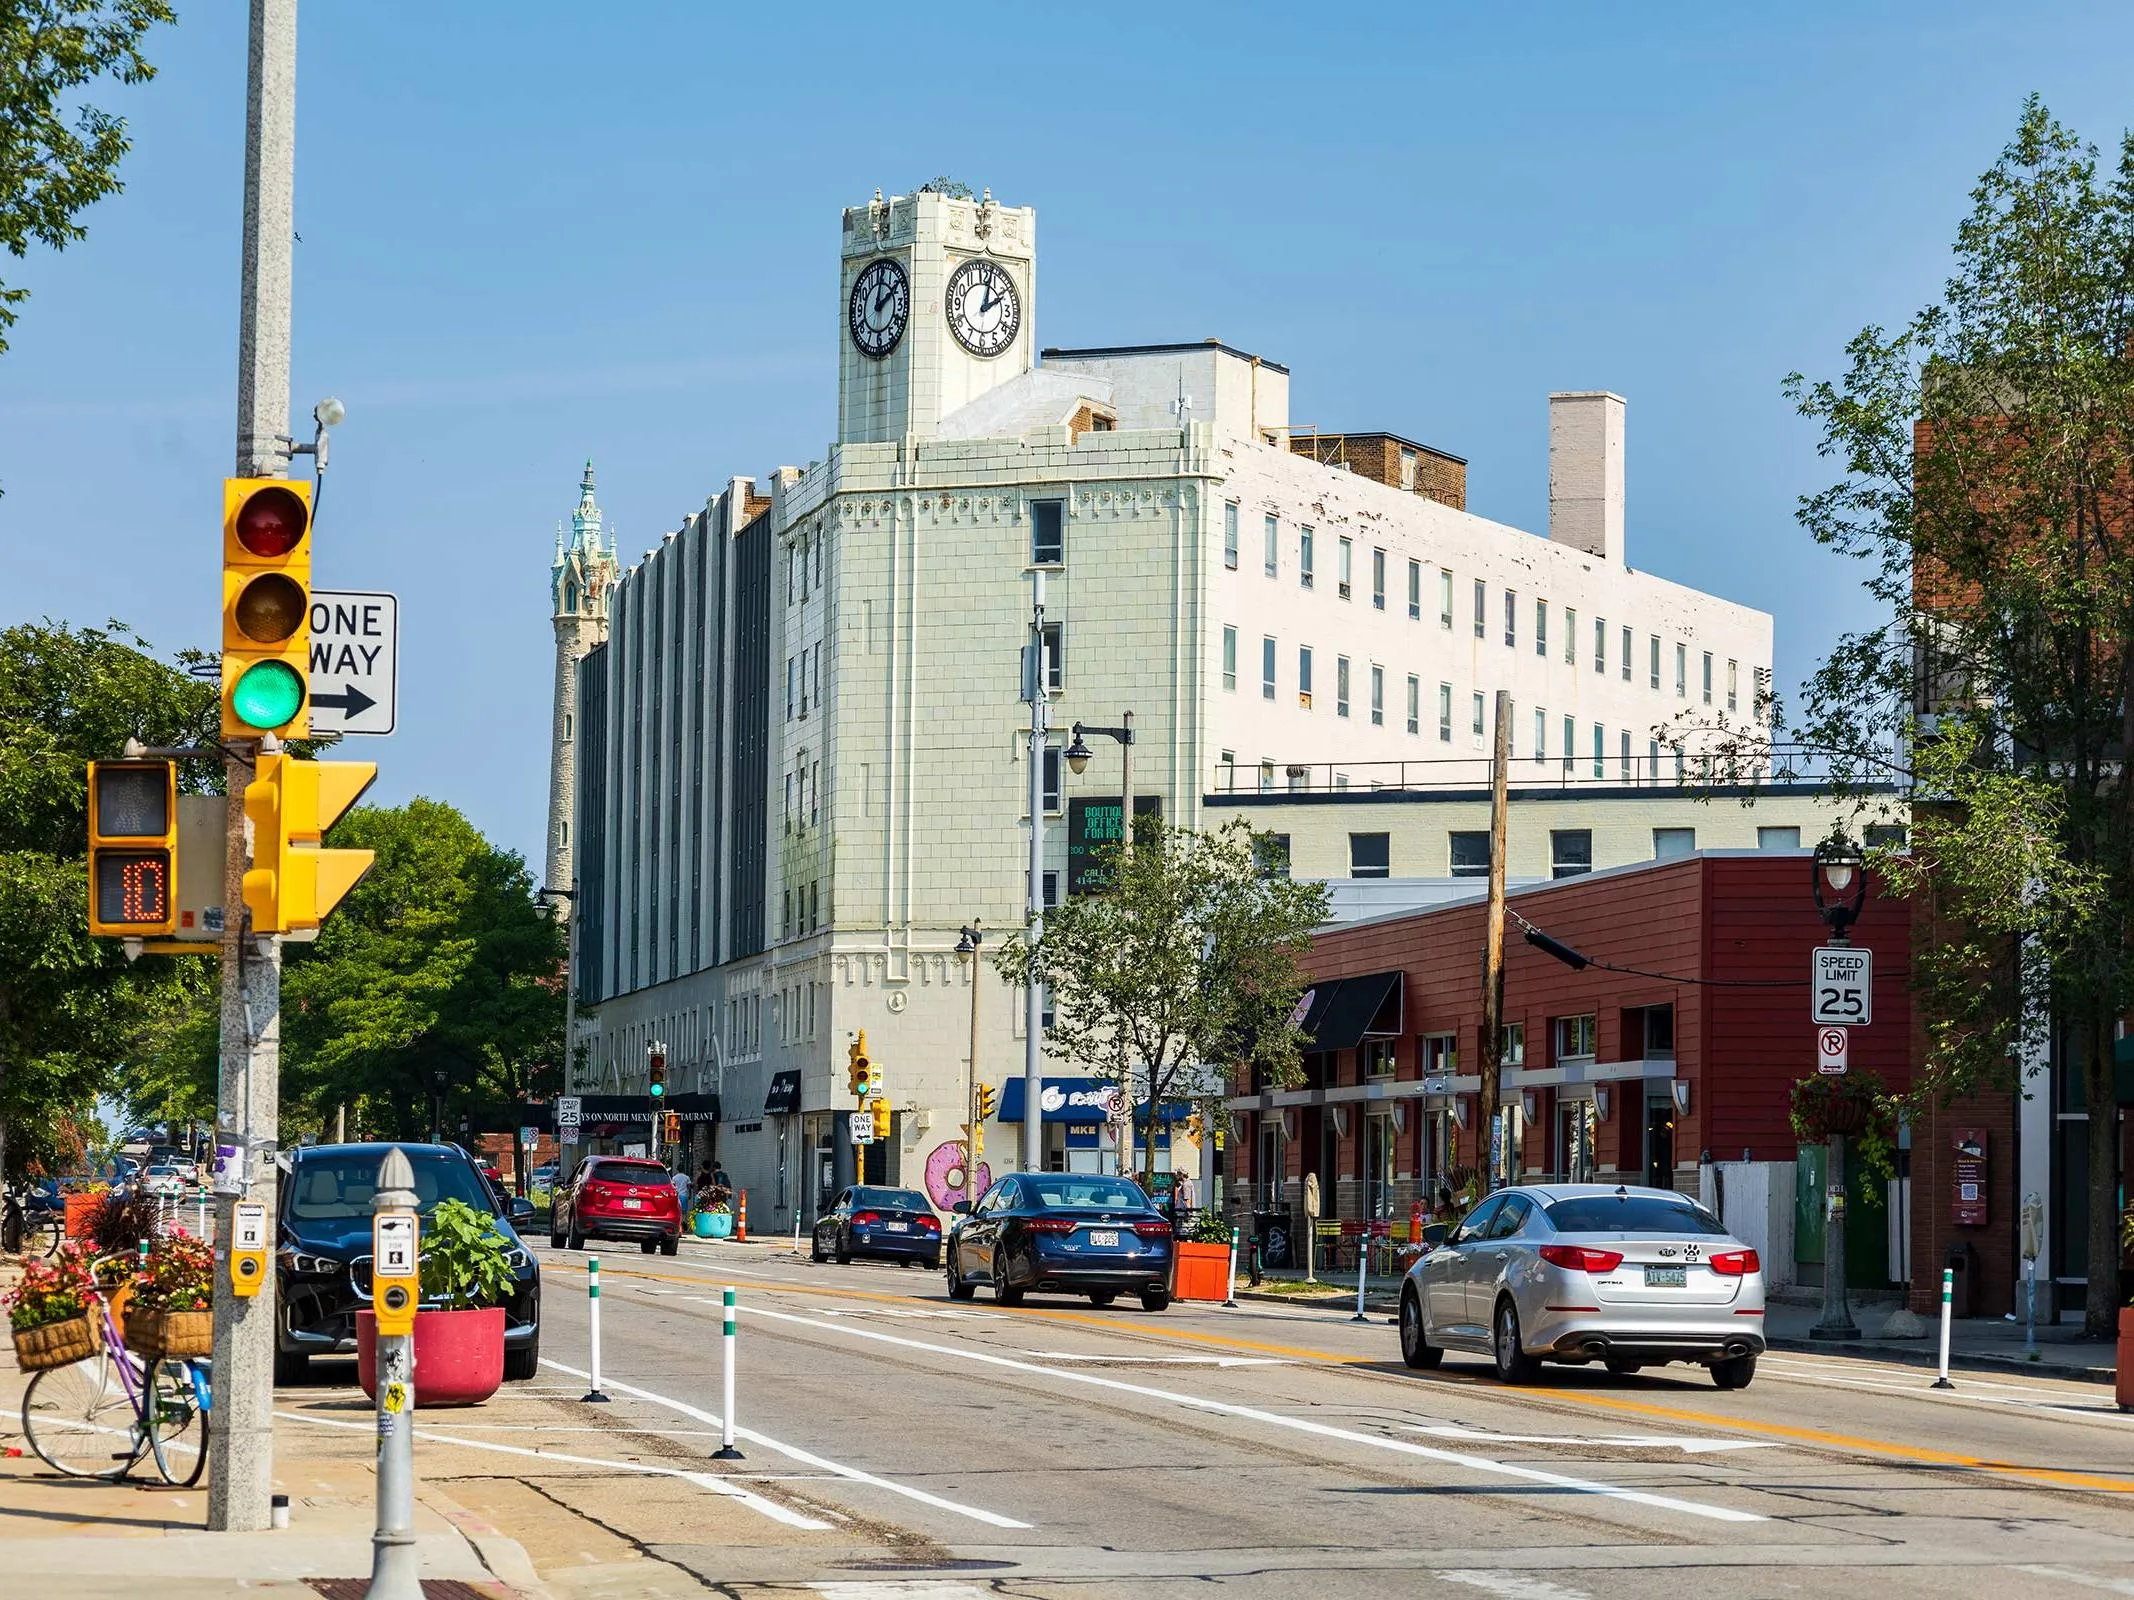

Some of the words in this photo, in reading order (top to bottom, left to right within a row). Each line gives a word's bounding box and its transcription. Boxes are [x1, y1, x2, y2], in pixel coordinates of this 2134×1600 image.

[955, 284, 966, 297] 10
[857, 304, 863, 317] 9
[897, 298, 903, 312] 3
[954, 298, 961, 311] 9
[1004, 305, 1011, 318] 3
[877, 333, 882, 347] 6
[967, 328, 974, 341] 7
[979, 333, 986, 347] 6
[991, 332, 998, 346] 5
[310, 603, 382, 636] ONE
[309, 643, 383, 676] WAY
[1084, 806, 1123, 818] BOUTIQU
[1087, 816, 1122, 828] OFFICE
[1084, 827, 1103, 839] FOR
[1106, 827, 1124, 839] REN
[1084, 869, 1103, 877] CALL
[123, 860, 163, 920] 10
[1820, 956, 1864, 969] SPEED
[1825, 970, 1858, 982] LIMIT
[1819, 988, 1863, 1016] 25
[560, 1112, 578, 1123] 25
[591, 1112, 602, 1121] ON
[603, 1112, 629, 1122] NORTH
[854, 1124, 871, 1132] WAY
[1070, 1126, 1096, 1135] MKE
